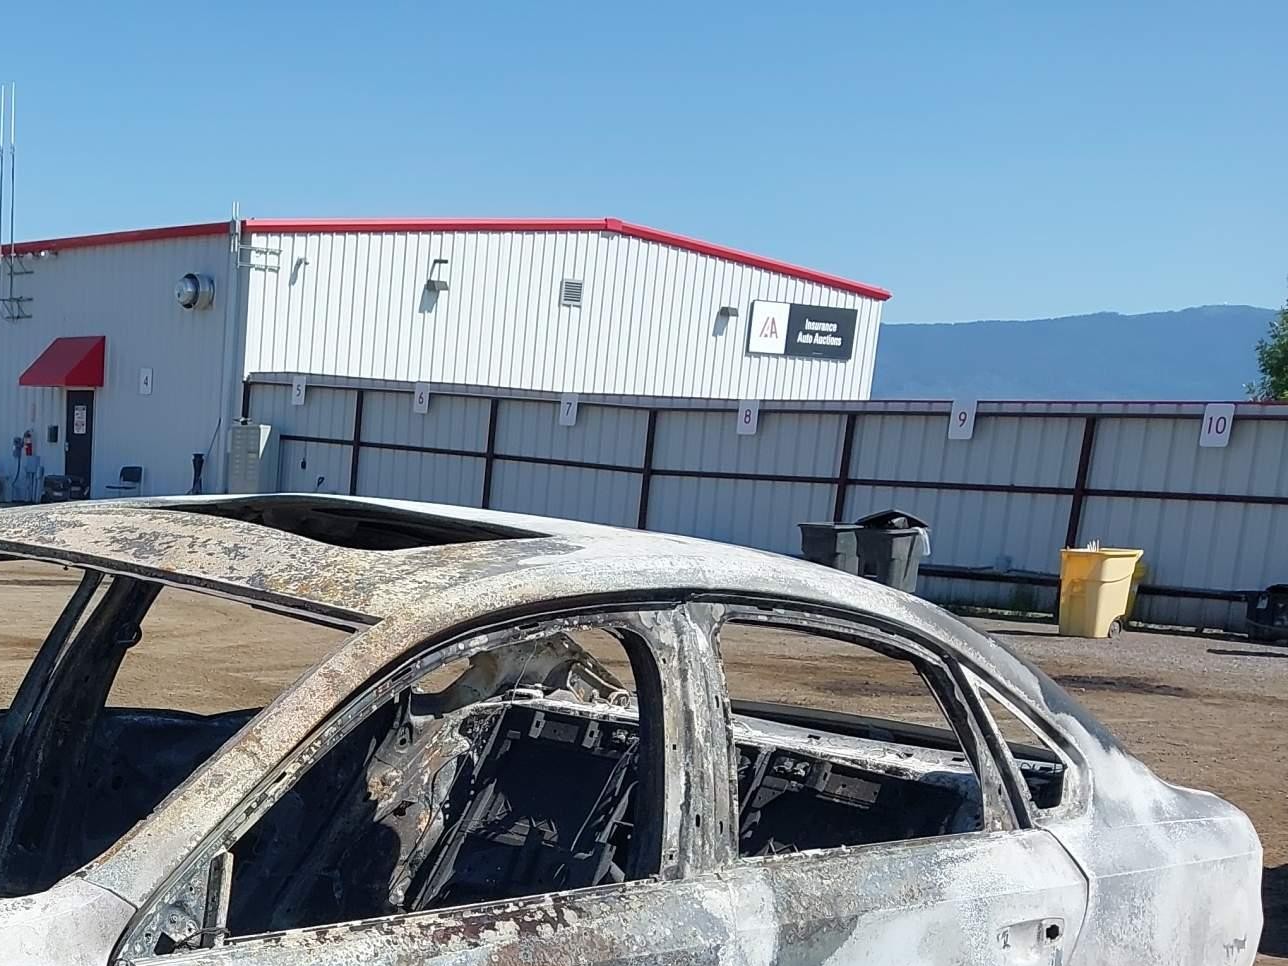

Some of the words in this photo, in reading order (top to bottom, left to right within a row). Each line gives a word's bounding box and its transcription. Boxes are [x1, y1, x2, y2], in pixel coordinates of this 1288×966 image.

[805, 318, 837, 332] Insurance
[797, 331, 813, 344] Auto
[813, 332, 842, 346] Auctions
[143, 375, 149, 387] 4
[296, 383, 302, 397] 5
[418, 391, 424, 404] 6
[566, 401, 572, 416] 7
[744, 408, 752, 424] 8
[958, 411, 968, 428] 9
[1207, 416, 1227, 434] 10
